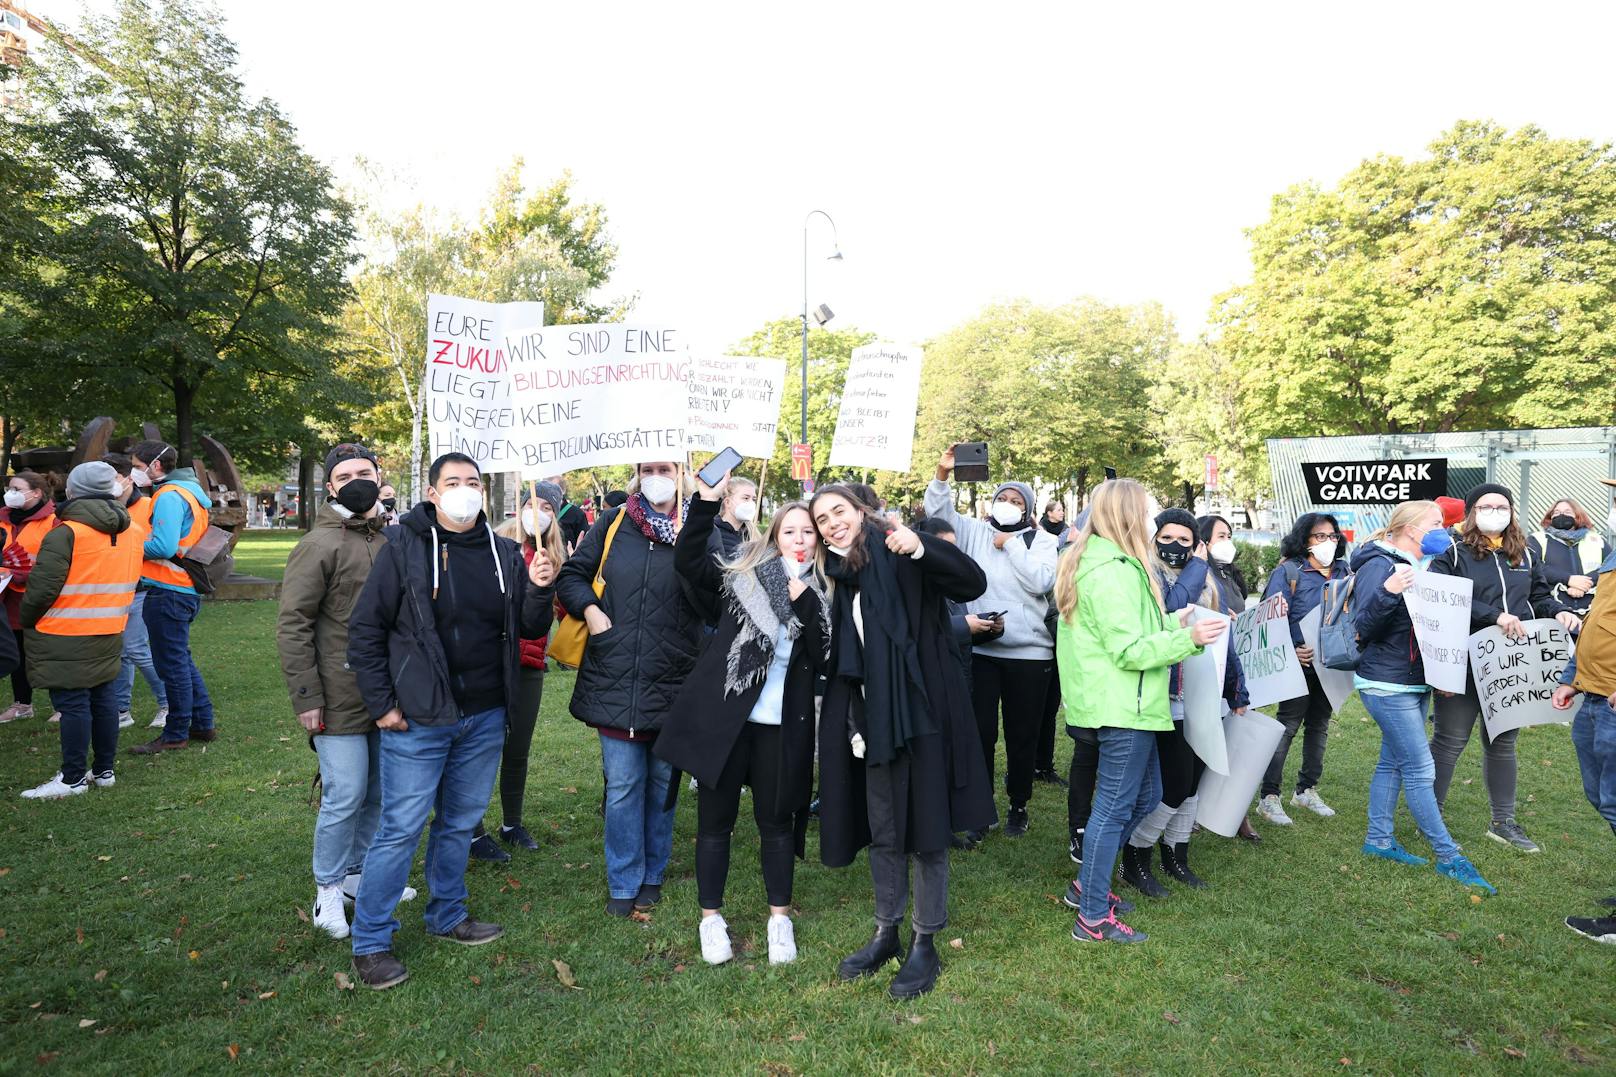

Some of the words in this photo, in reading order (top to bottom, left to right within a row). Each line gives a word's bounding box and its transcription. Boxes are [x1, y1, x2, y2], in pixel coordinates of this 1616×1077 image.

[435, 311, 494, 341] EURE
[505, 332, 546, 363] WIR
[567, 329, 610, 356] SIND
[625, 328, 677, 353] EINE
[431, 368, 501, 400] LIEGT
[520, 399, 582, 428] KEINE
[751, 422, 777, 433] STATT
[1314, 462, 1432, 483] VOTIVPARK
[1319, 482, 1411, 501] GARAGE
[1257, 622, 1268, 649] IN
[1477, 638, 1496, 658] SO
[1498, 652, 1530, 670] WIR
[1541, 648, 1571, 662] BE
[1501, 691, 1526, 709] GAR
